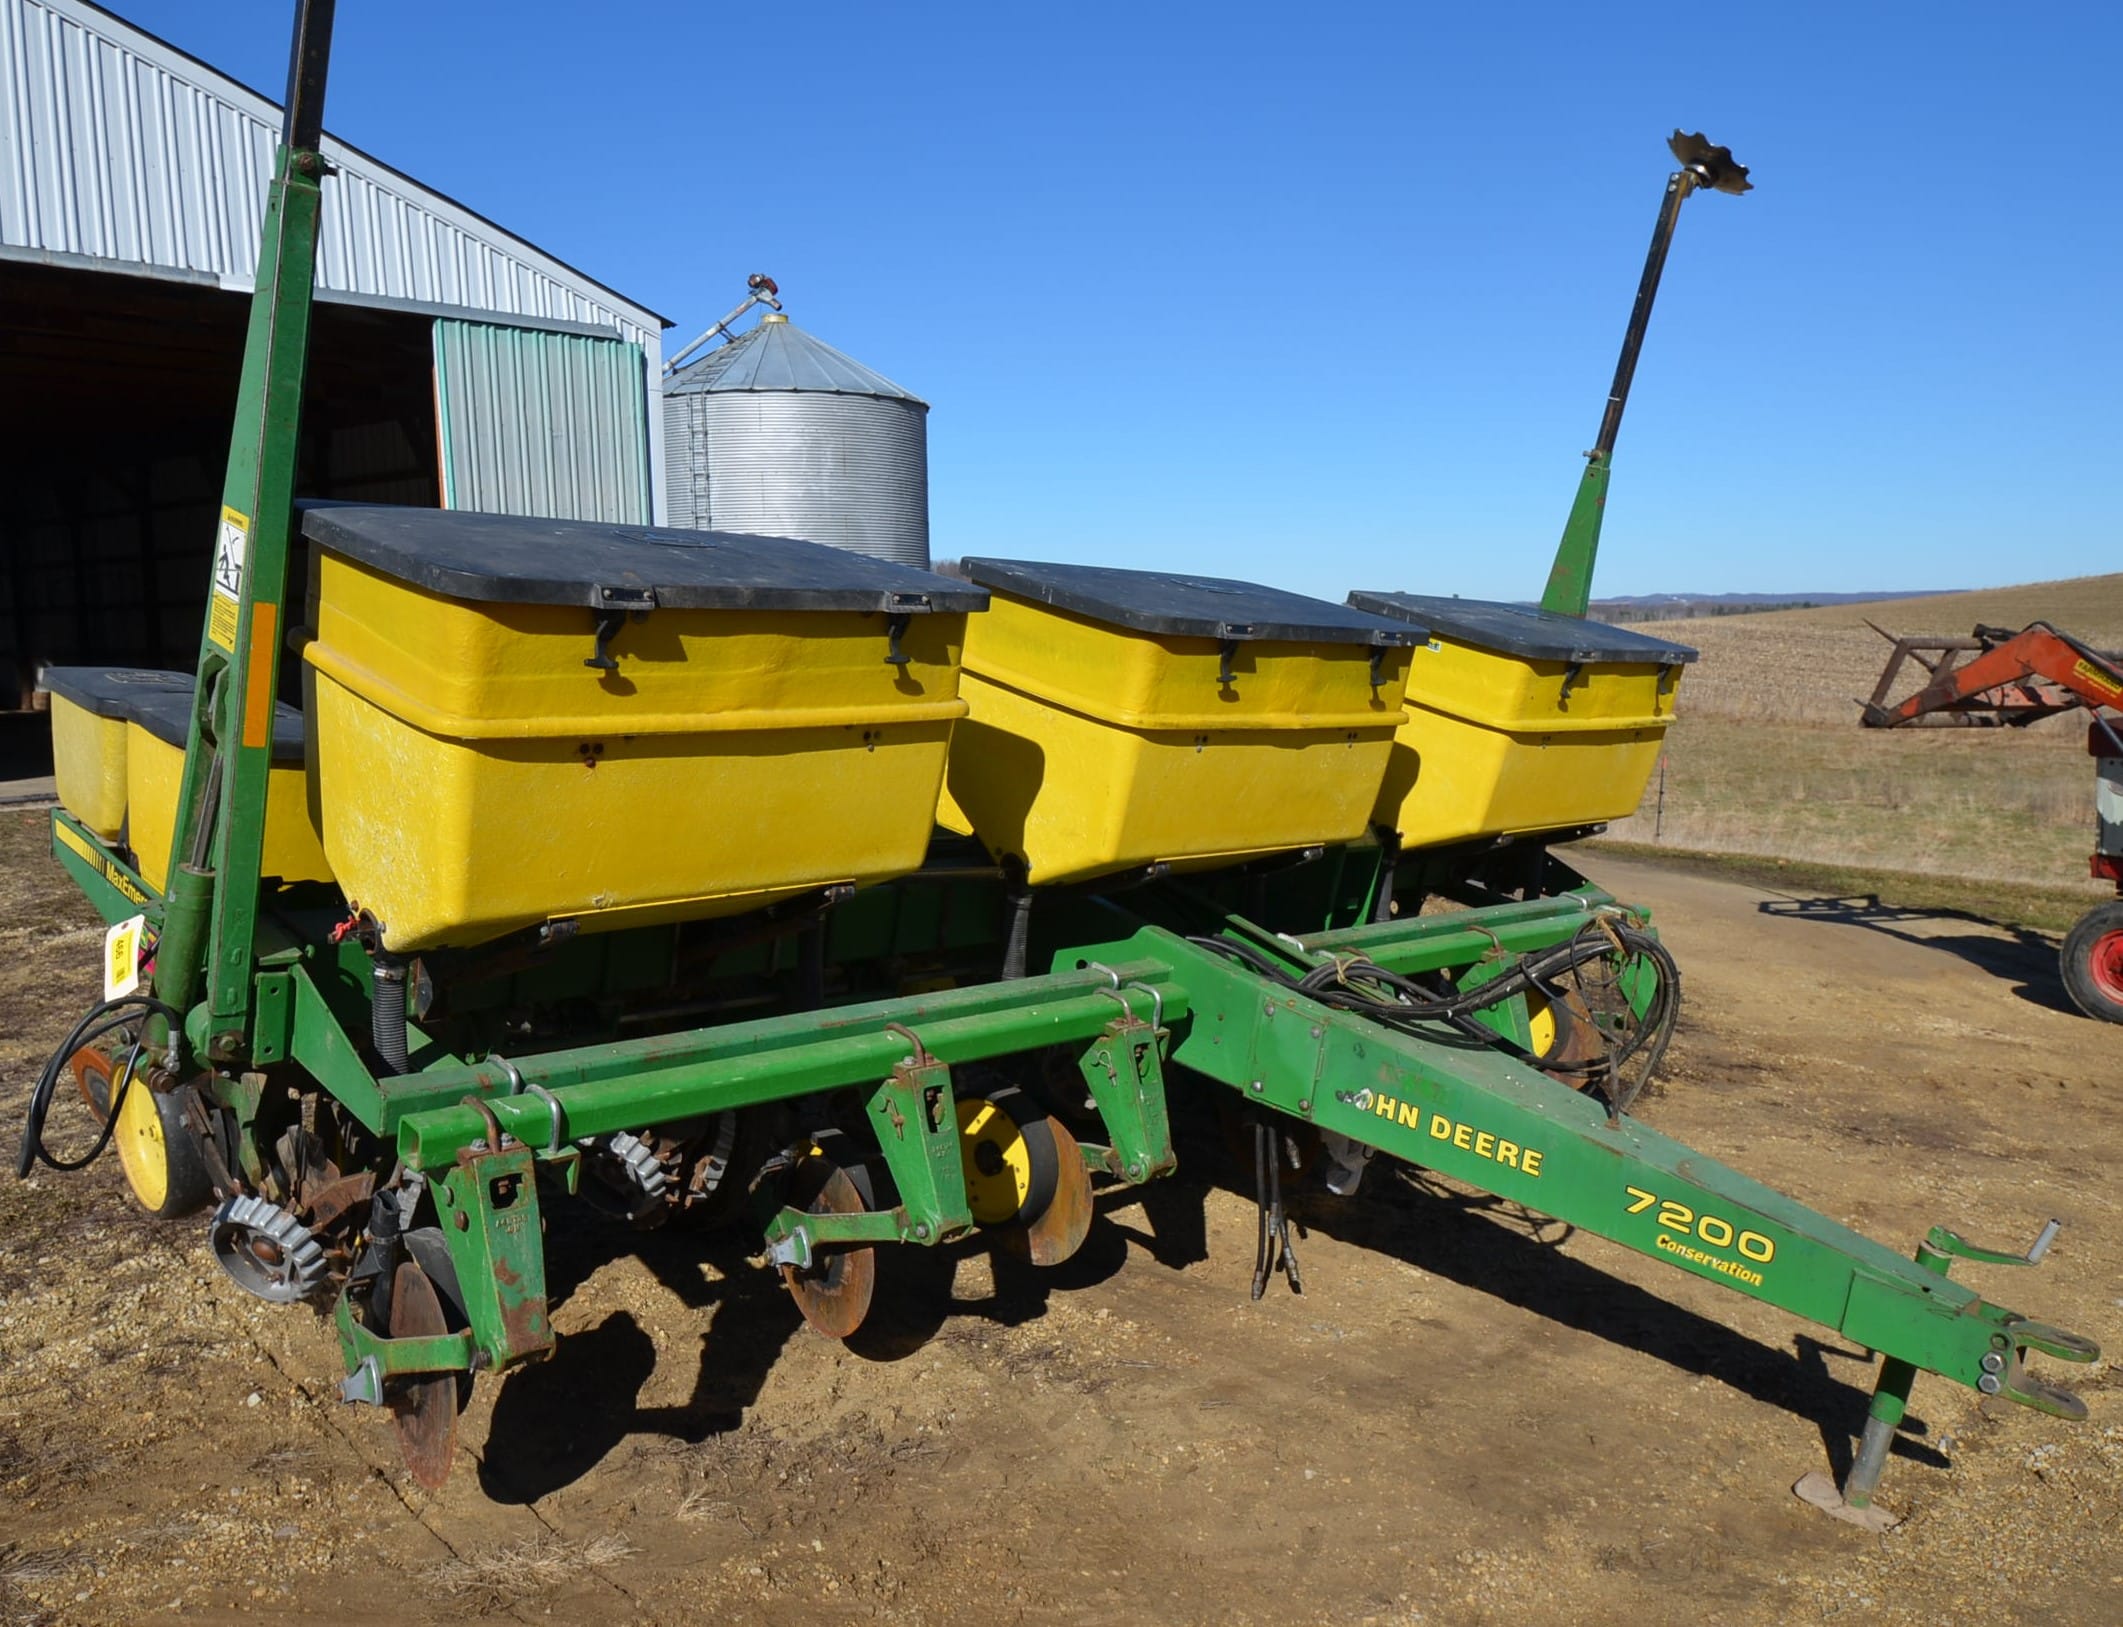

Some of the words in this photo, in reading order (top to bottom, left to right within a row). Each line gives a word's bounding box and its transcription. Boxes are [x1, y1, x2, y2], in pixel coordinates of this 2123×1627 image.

[1335, 1088, 1420, 1130] OHN
[1429, 1113, 1544, 1178] DEERE
[1624, 1185, 1776, 1263] 7200
[1656, 1233, 1763, 1287] Conservation
